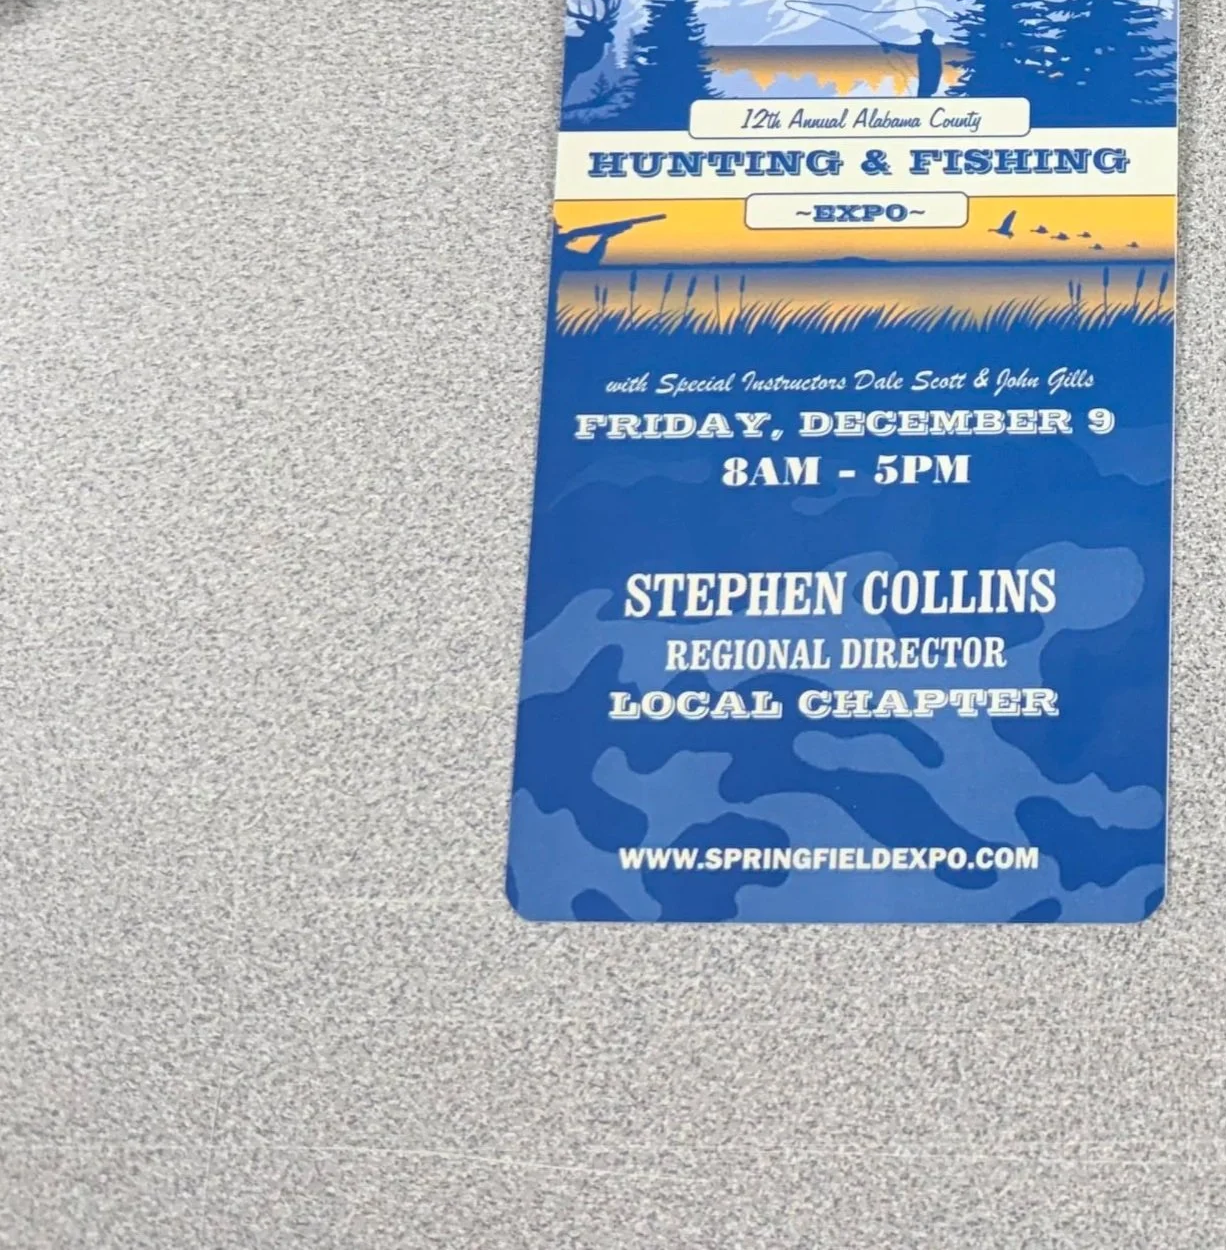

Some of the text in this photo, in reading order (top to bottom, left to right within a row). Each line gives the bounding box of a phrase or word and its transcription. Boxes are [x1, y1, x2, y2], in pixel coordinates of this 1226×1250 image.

[740, 106, 982, 133] 12th Annual Alabama County
[587, 147, 1131, 179] HUNTING & FISHING
[605, 366, 1094, 397] with Special Instructors Dale Scott & John Gills
[574, 407, 1116, 441] FRIDAY, DECEMBER 9
[722, 456, 821, 487] 8AM
[873, 454, 970, 485] 5PM
[624, 568, 1057, 618] STEPHEN COLLINS
[665, 636, 1008, 671] REGIONAL DIRECTOR
[608, 688, 1060, 721] LOCAL CHAPTER
[618, 846, 1039, 871] WWW.SPRINGFIELDEXPO.COM
